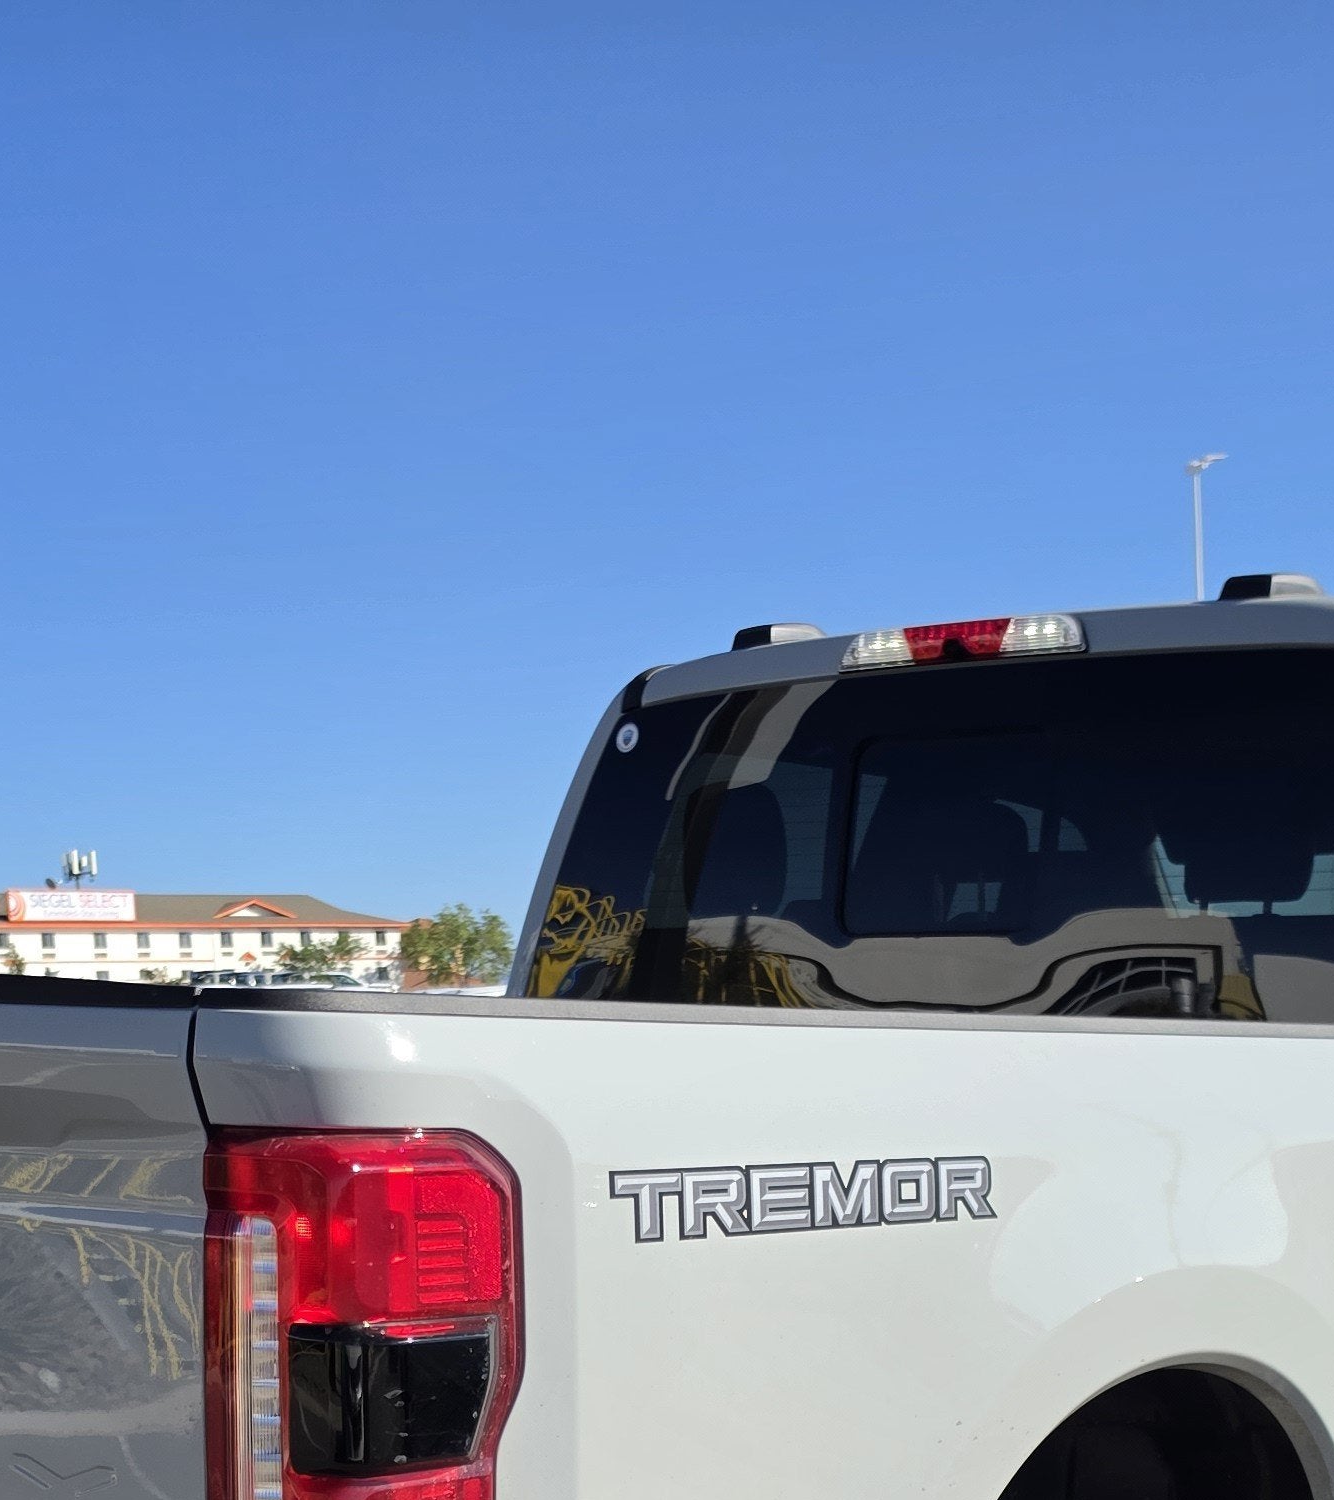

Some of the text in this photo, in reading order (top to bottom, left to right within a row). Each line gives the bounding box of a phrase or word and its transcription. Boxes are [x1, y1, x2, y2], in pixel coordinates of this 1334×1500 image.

[28, 894, 128, 909] SIEGEL SELECT
[608, 1155, 998, 1244] TREMOR
